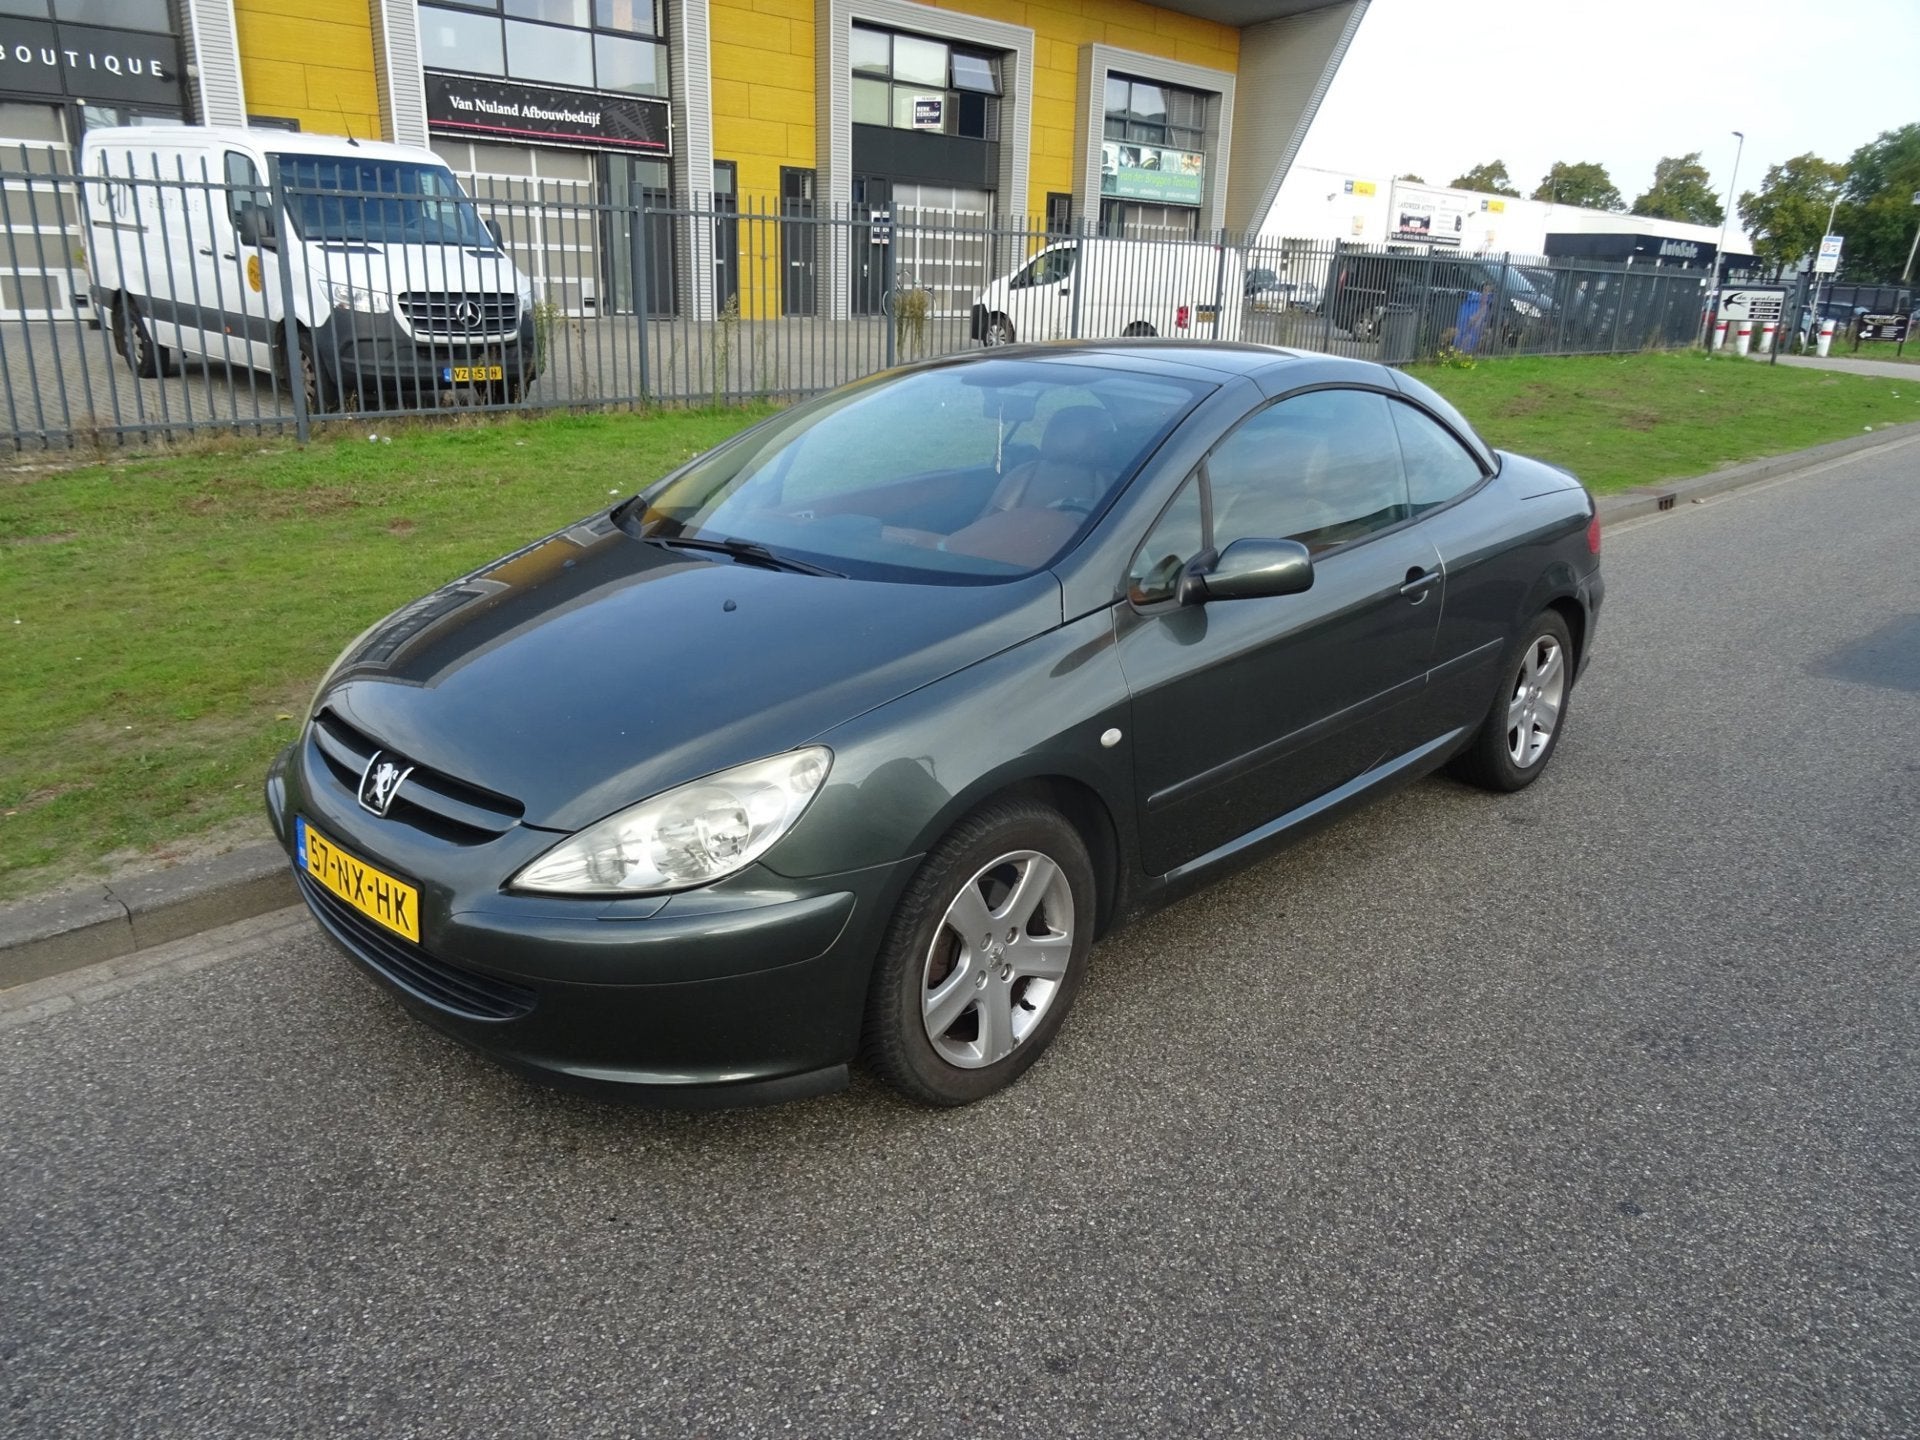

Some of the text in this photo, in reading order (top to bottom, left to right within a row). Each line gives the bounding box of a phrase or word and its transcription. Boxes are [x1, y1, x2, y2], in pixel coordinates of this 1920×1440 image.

[449, 95, 602, 128] Van Nuland Afbouwbedrijf
[310, 834, 411, 932] 57-NX-HK
